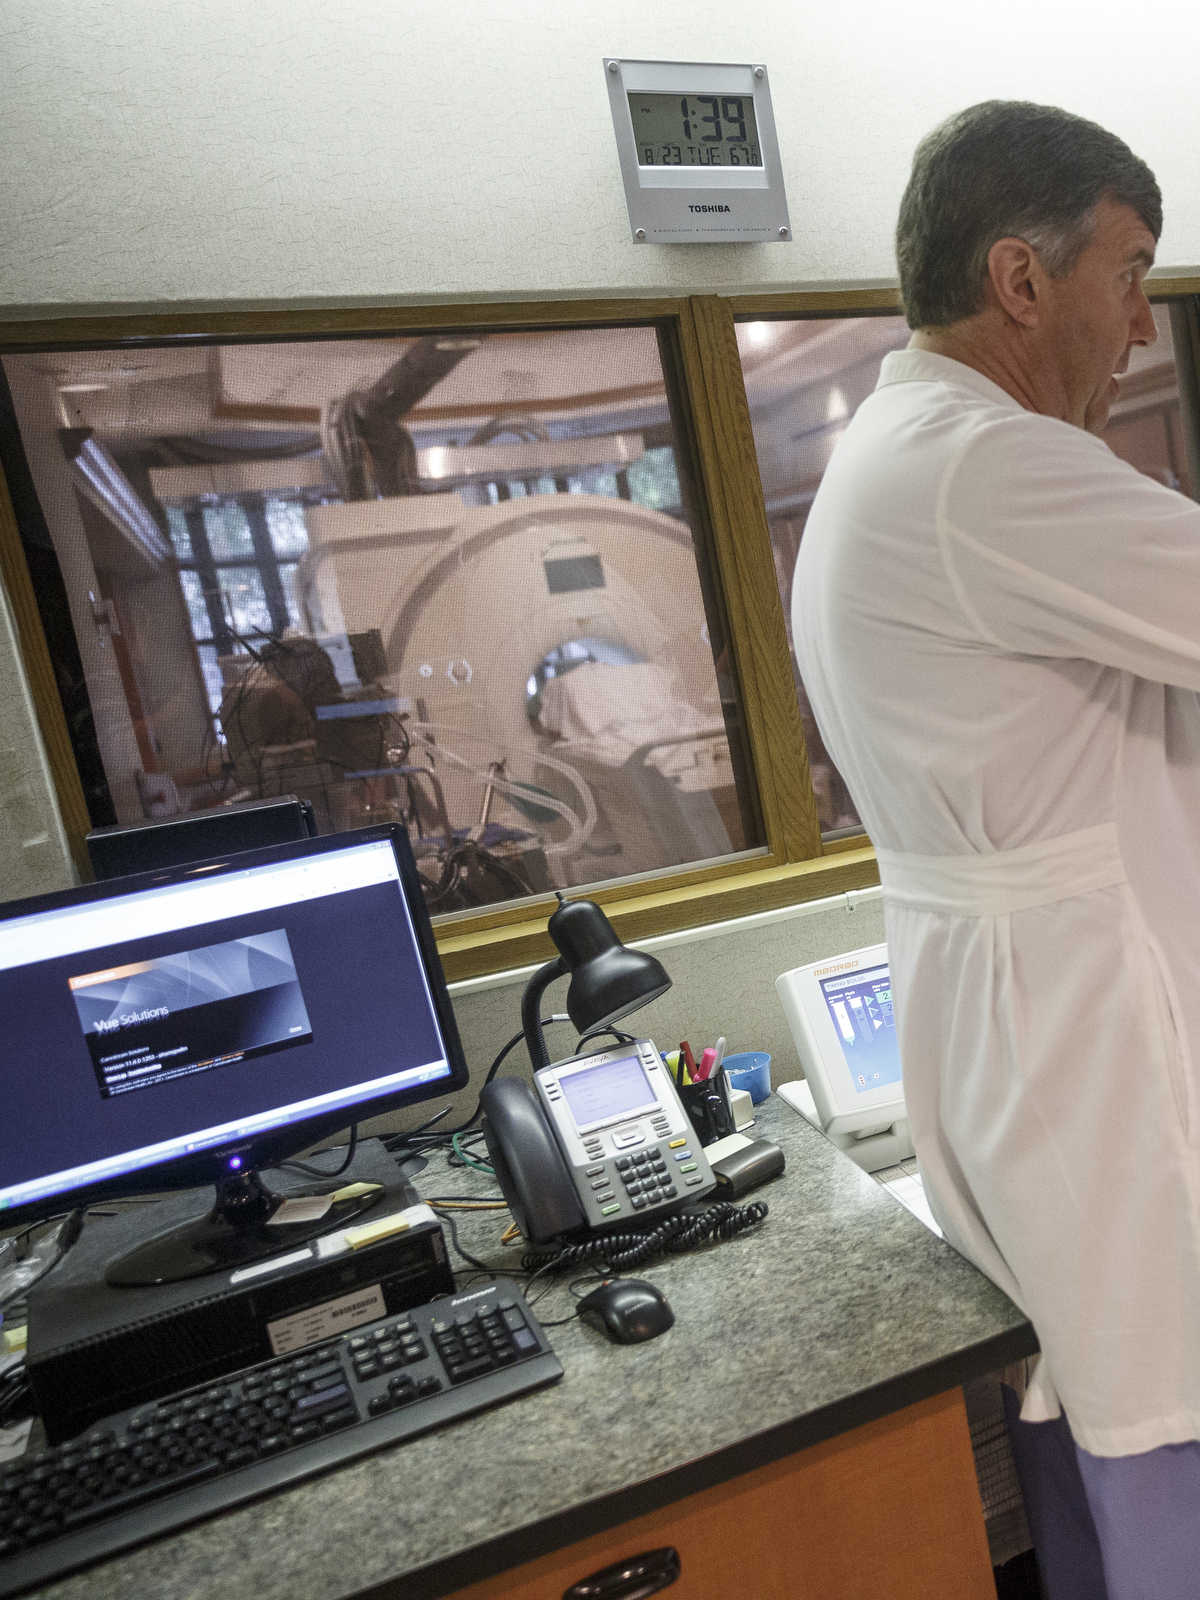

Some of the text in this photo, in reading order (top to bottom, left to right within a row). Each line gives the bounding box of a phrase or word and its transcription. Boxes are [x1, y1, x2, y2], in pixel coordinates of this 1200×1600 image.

[681, 96, 747, 142] 1:39
[644, 146, 682, 165] 8/23
[686, 146, 721, 166] TUE
[688, 204, 731, 213] TOSHIBA
[826, 975, 866, 990] TIMING BOLUS
[93, 1006, 169, 1033] Vue Solutions
[128, 1046, 150, 1056] Solutions
[104, 1062, 125, 1073] Version
[583, 1054, 610, 1067] AVAYA
